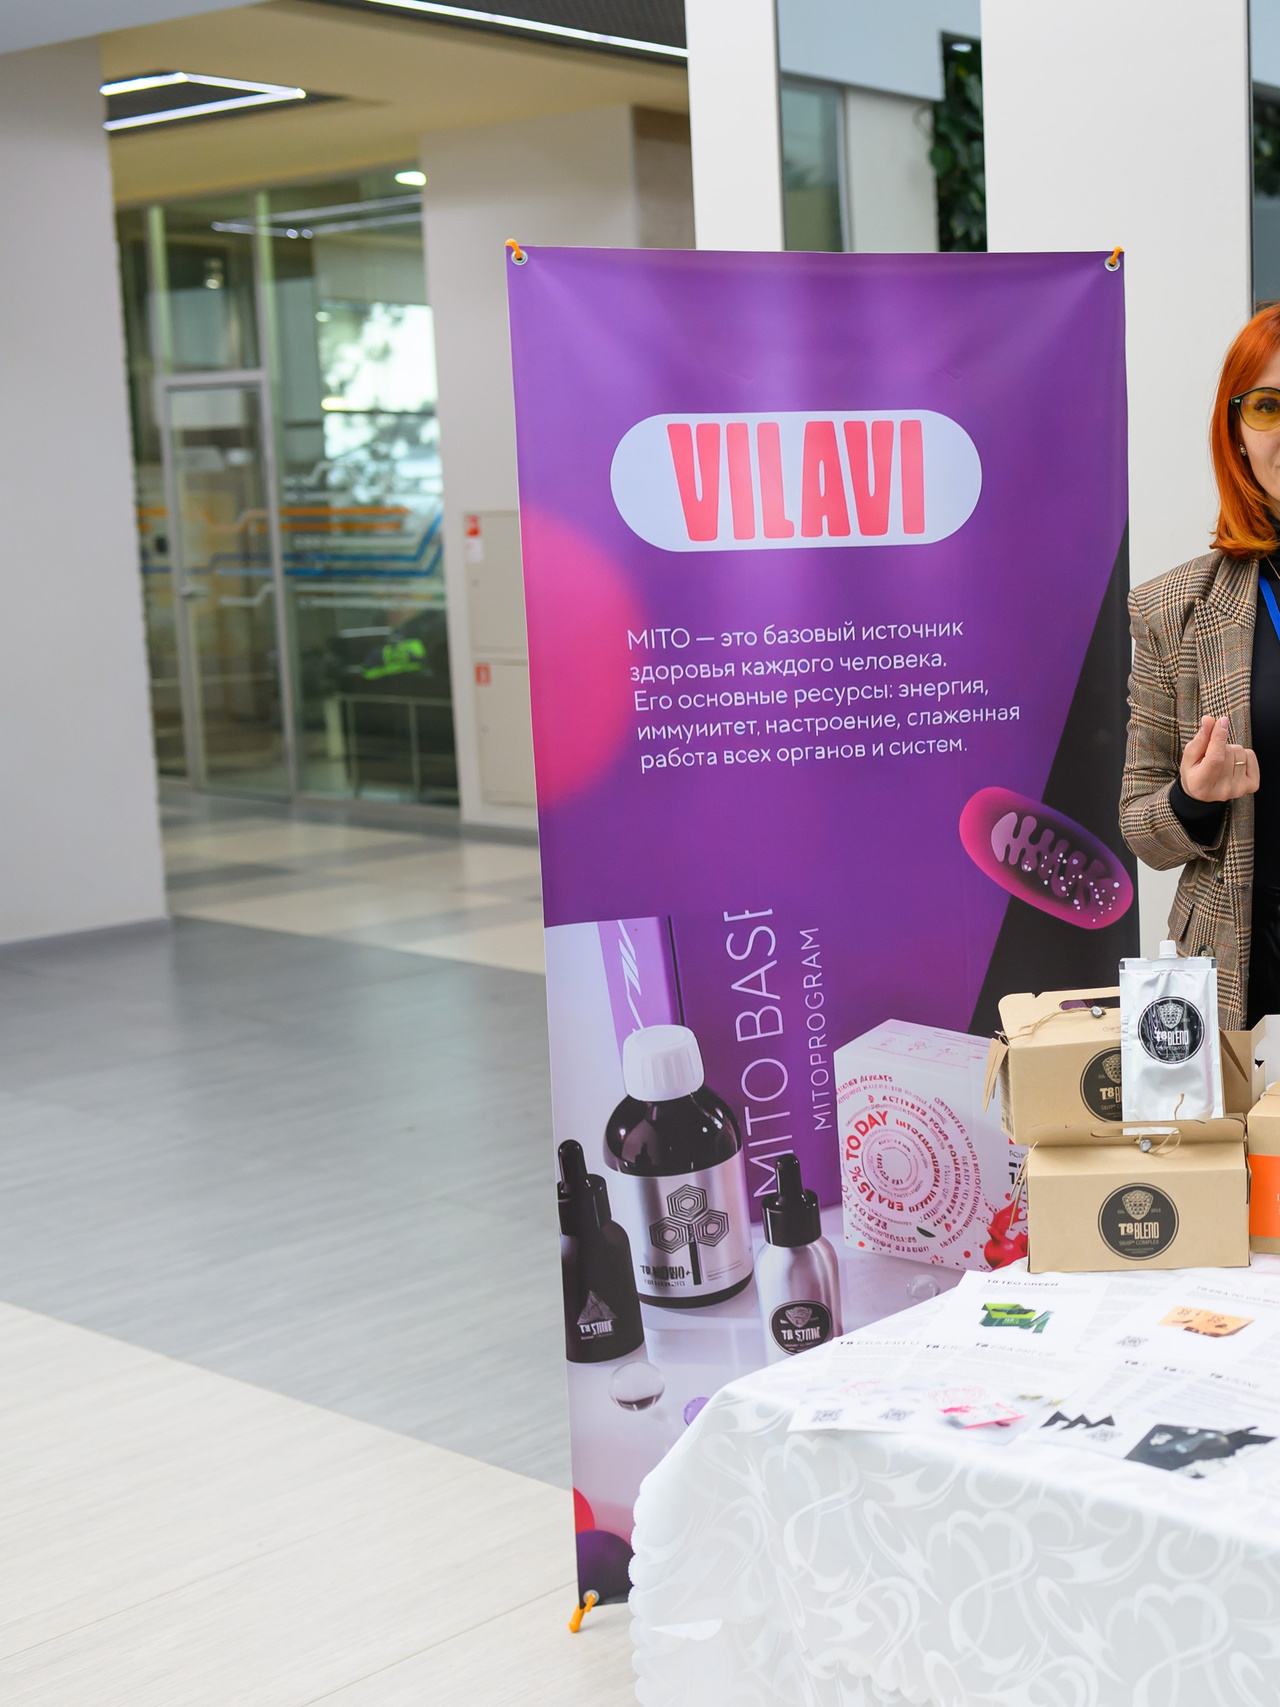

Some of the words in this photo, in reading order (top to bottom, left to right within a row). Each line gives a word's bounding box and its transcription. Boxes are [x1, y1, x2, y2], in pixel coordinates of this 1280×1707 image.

[667, 420, 925, 541] VILAVI
[720, 631, 758, 647] это
[763, 621, 856, 645] базовый
[861, 621, 964, 641] источник
[630, 662, 735, 685] здоровья
[741, 657, 834, 677] каждого
[839, 652, 947, 672] человека.
[634, 690, 673, 711] Его
[678, 690, 788, 709] основные
[794, 684, 893, 709] ресурсы:
[898, 679, 989, 702] энергия,
[766, 713, 900, 736] настроение,
[907, 706, 1020, 726] слаженная
[641, 747, 717, 774] работа
[724, 748, 771, 764] всех
[776, 743, 866, 767] органов
[872, 742, 884, 756] и
[889, 738, 968, 756] систем.
[799, 928, 832, 1131] MITOPROGRAM
[1167, 1030, 1189, 1046] BLEND
[1099, 1087, 1114, 1100] T8
[740, 1058, 794, 1198] MITO
[1118, 1222, 1133, 1236] T8
[1134, 1222, 1159, 1240] BLEND
